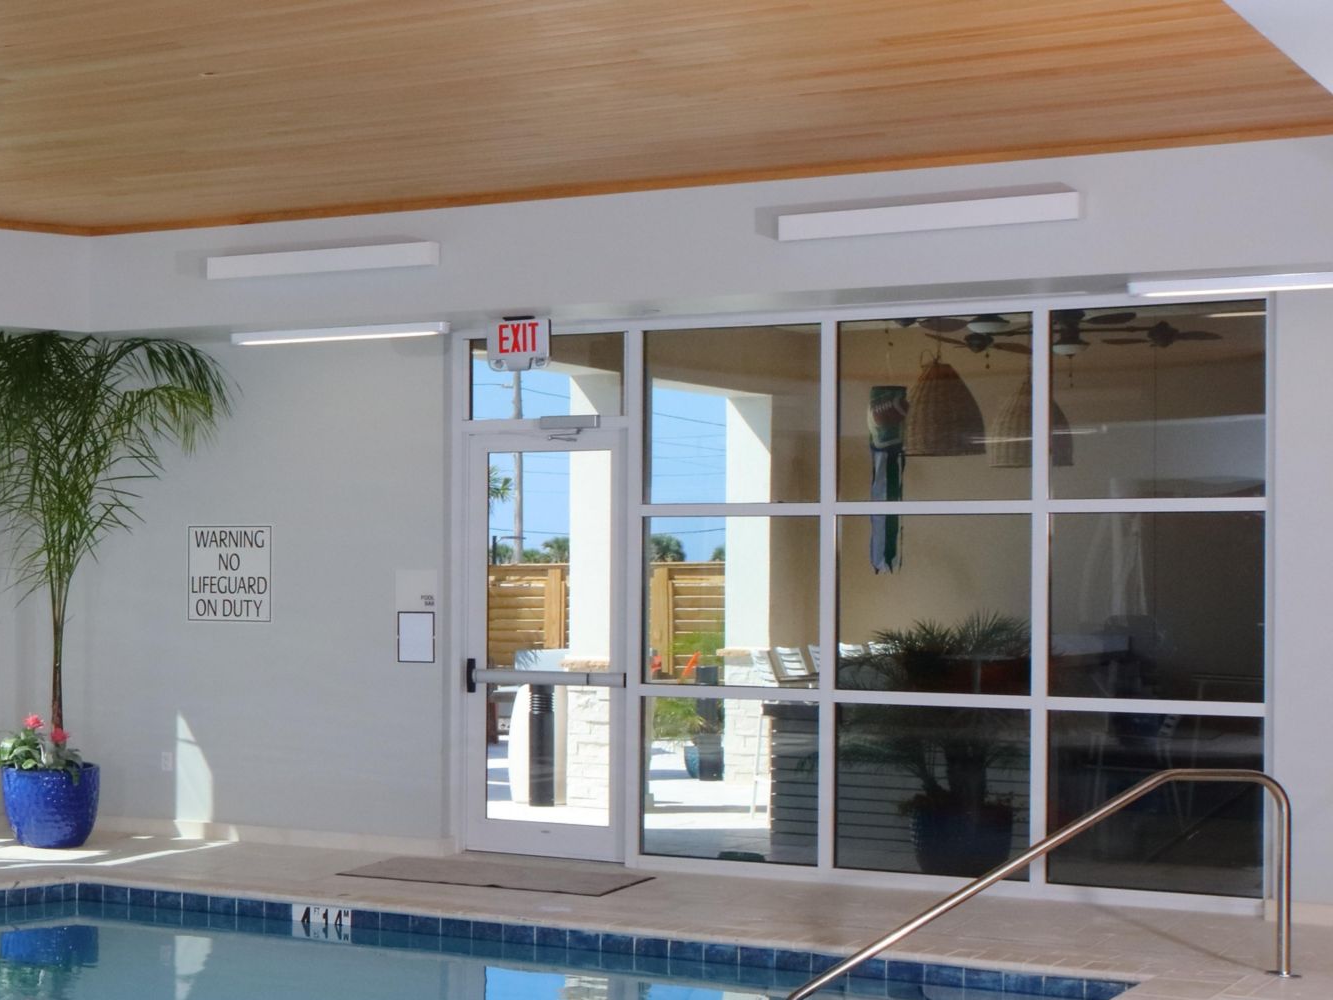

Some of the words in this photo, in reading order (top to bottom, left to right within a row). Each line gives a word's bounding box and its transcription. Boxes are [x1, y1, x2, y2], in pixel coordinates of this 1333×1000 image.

[498, 322, 539, 354] EXIT
[194, 530, 265, 549] WARNING
[218, 553, 240, 572] NO
[191, 576, 268, 595] LIFEGUARD
[196, 598, 218, 617] ON
[222, 599, 263, 618] DUTY
